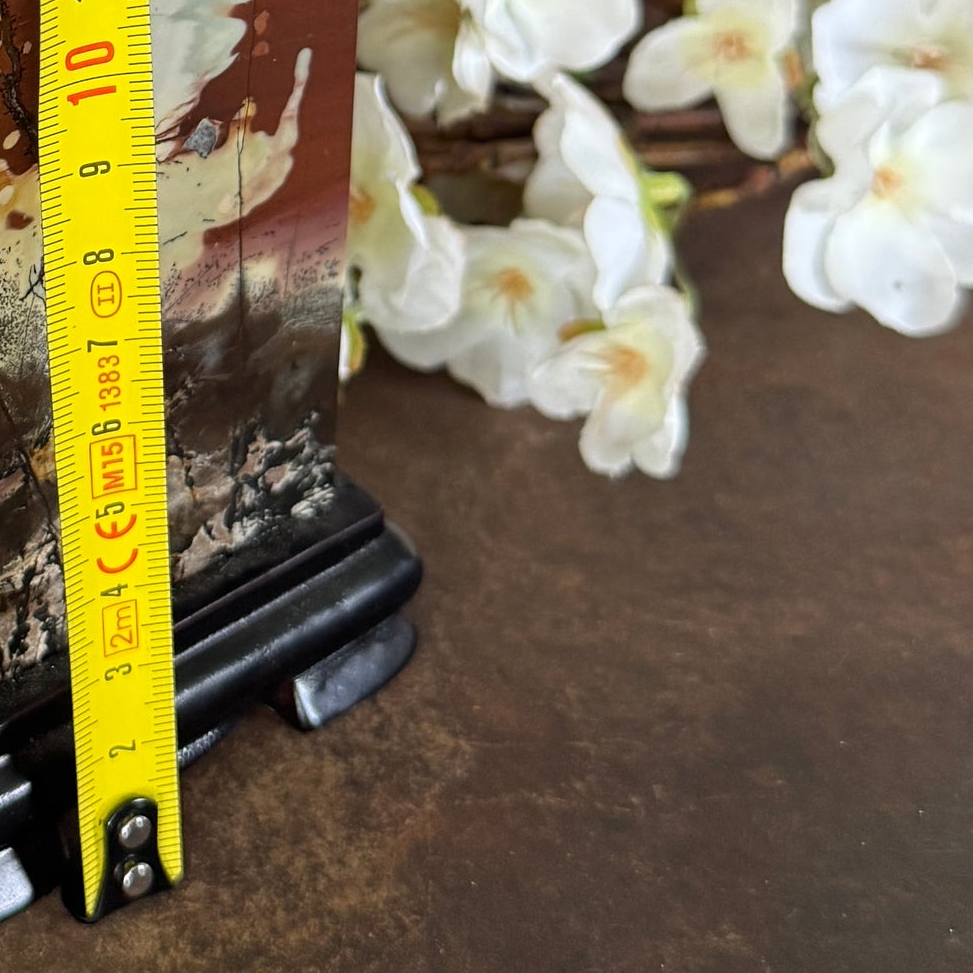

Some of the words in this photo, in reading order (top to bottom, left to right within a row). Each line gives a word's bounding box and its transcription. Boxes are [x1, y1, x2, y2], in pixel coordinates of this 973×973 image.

[65, 41, 116, 106] 10
[79, 160, 111, 178] 9
[83, 248, 114, 265] 8
[87, 339, 118, 353] 7
[99, 354, 121, 412] 1383
[91, 418, 122, 437] 6
[101, 442, 125, 492] M15
[96, 501, 125, 519] 5
[100, 583, 128, 597] 4
[110, 606, 133, 649] 2m
[104, 662, 133, 682] 3
[108, 739, 136, 759] 2
